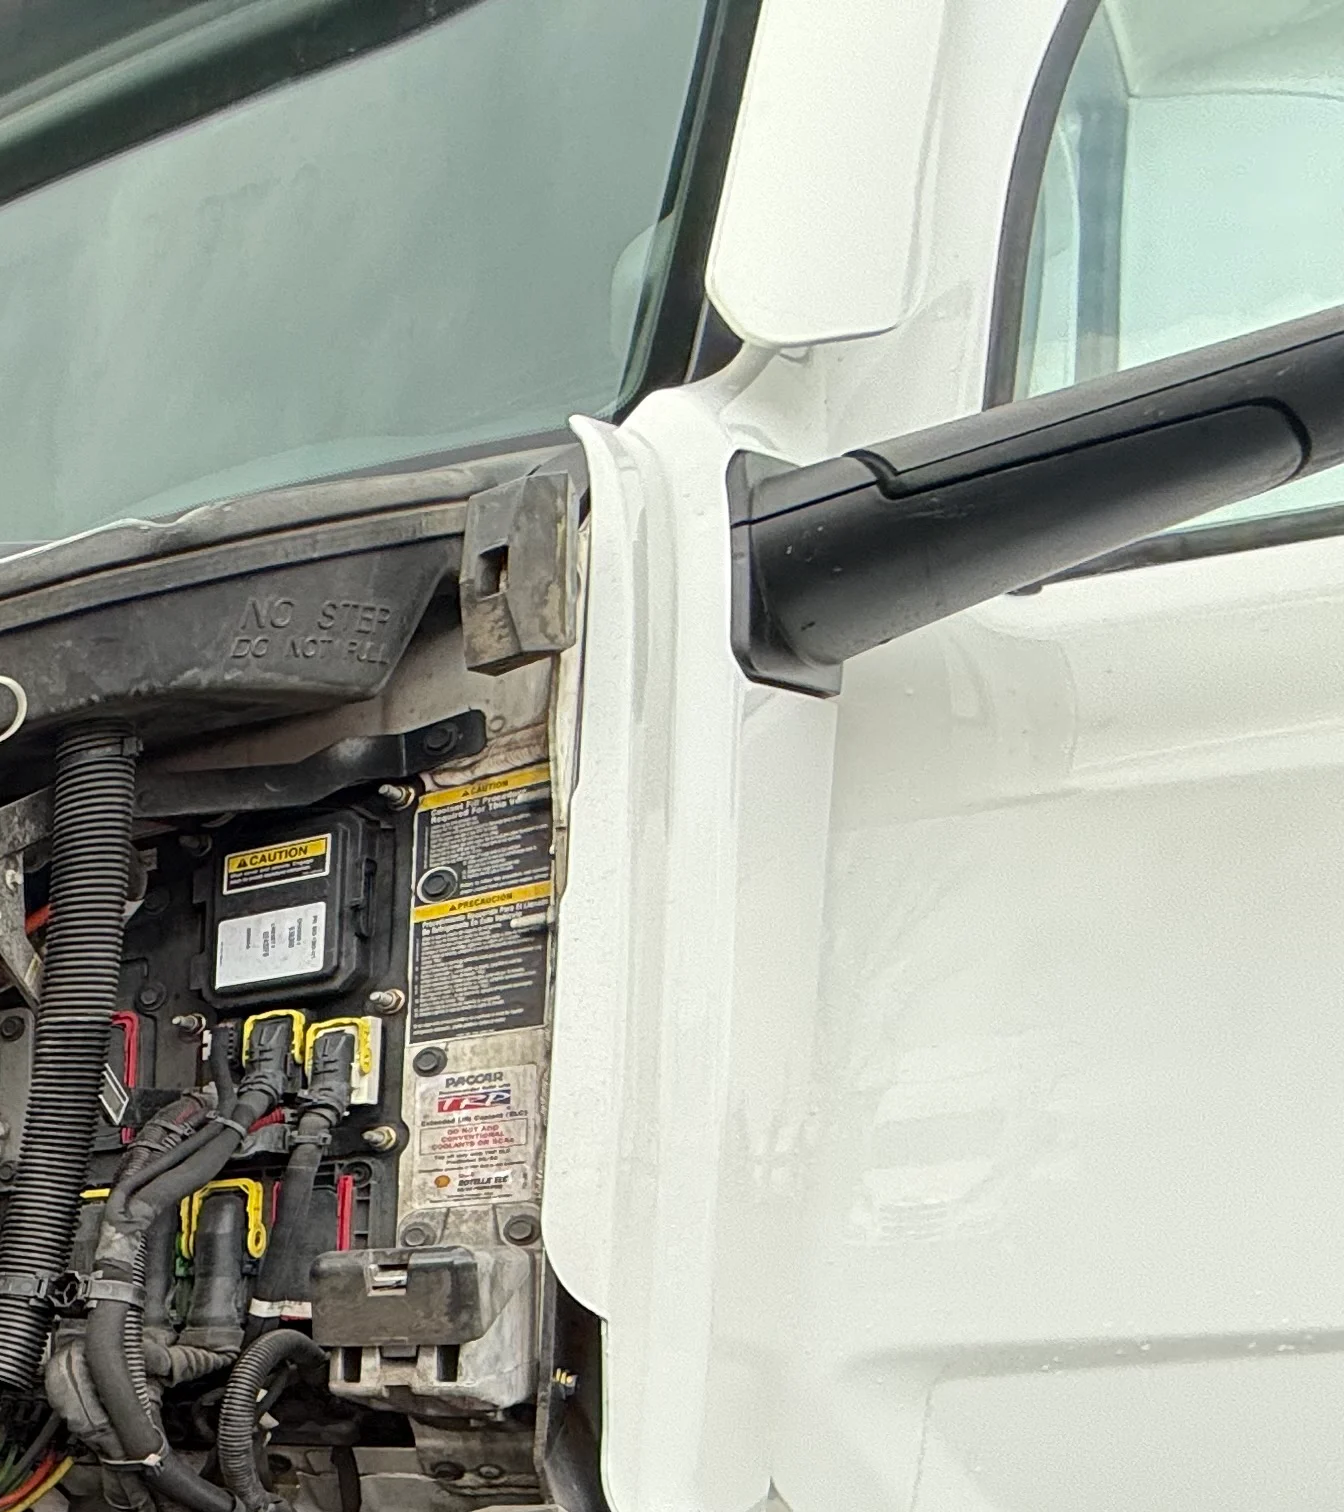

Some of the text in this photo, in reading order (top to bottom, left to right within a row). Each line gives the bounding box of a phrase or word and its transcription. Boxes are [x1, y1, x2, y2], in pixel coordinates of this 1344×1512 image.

[241, 597, 391, 634] NO STEP
[230, 636, 390, 665] DO NOT PULL
[471, 779, 509, 795] CAUTION
[249, 845, 308, 866] CAUTION
[446, 1072, 503, 1088] PACCAR
[438, 1091, 511, 1111] TRP
